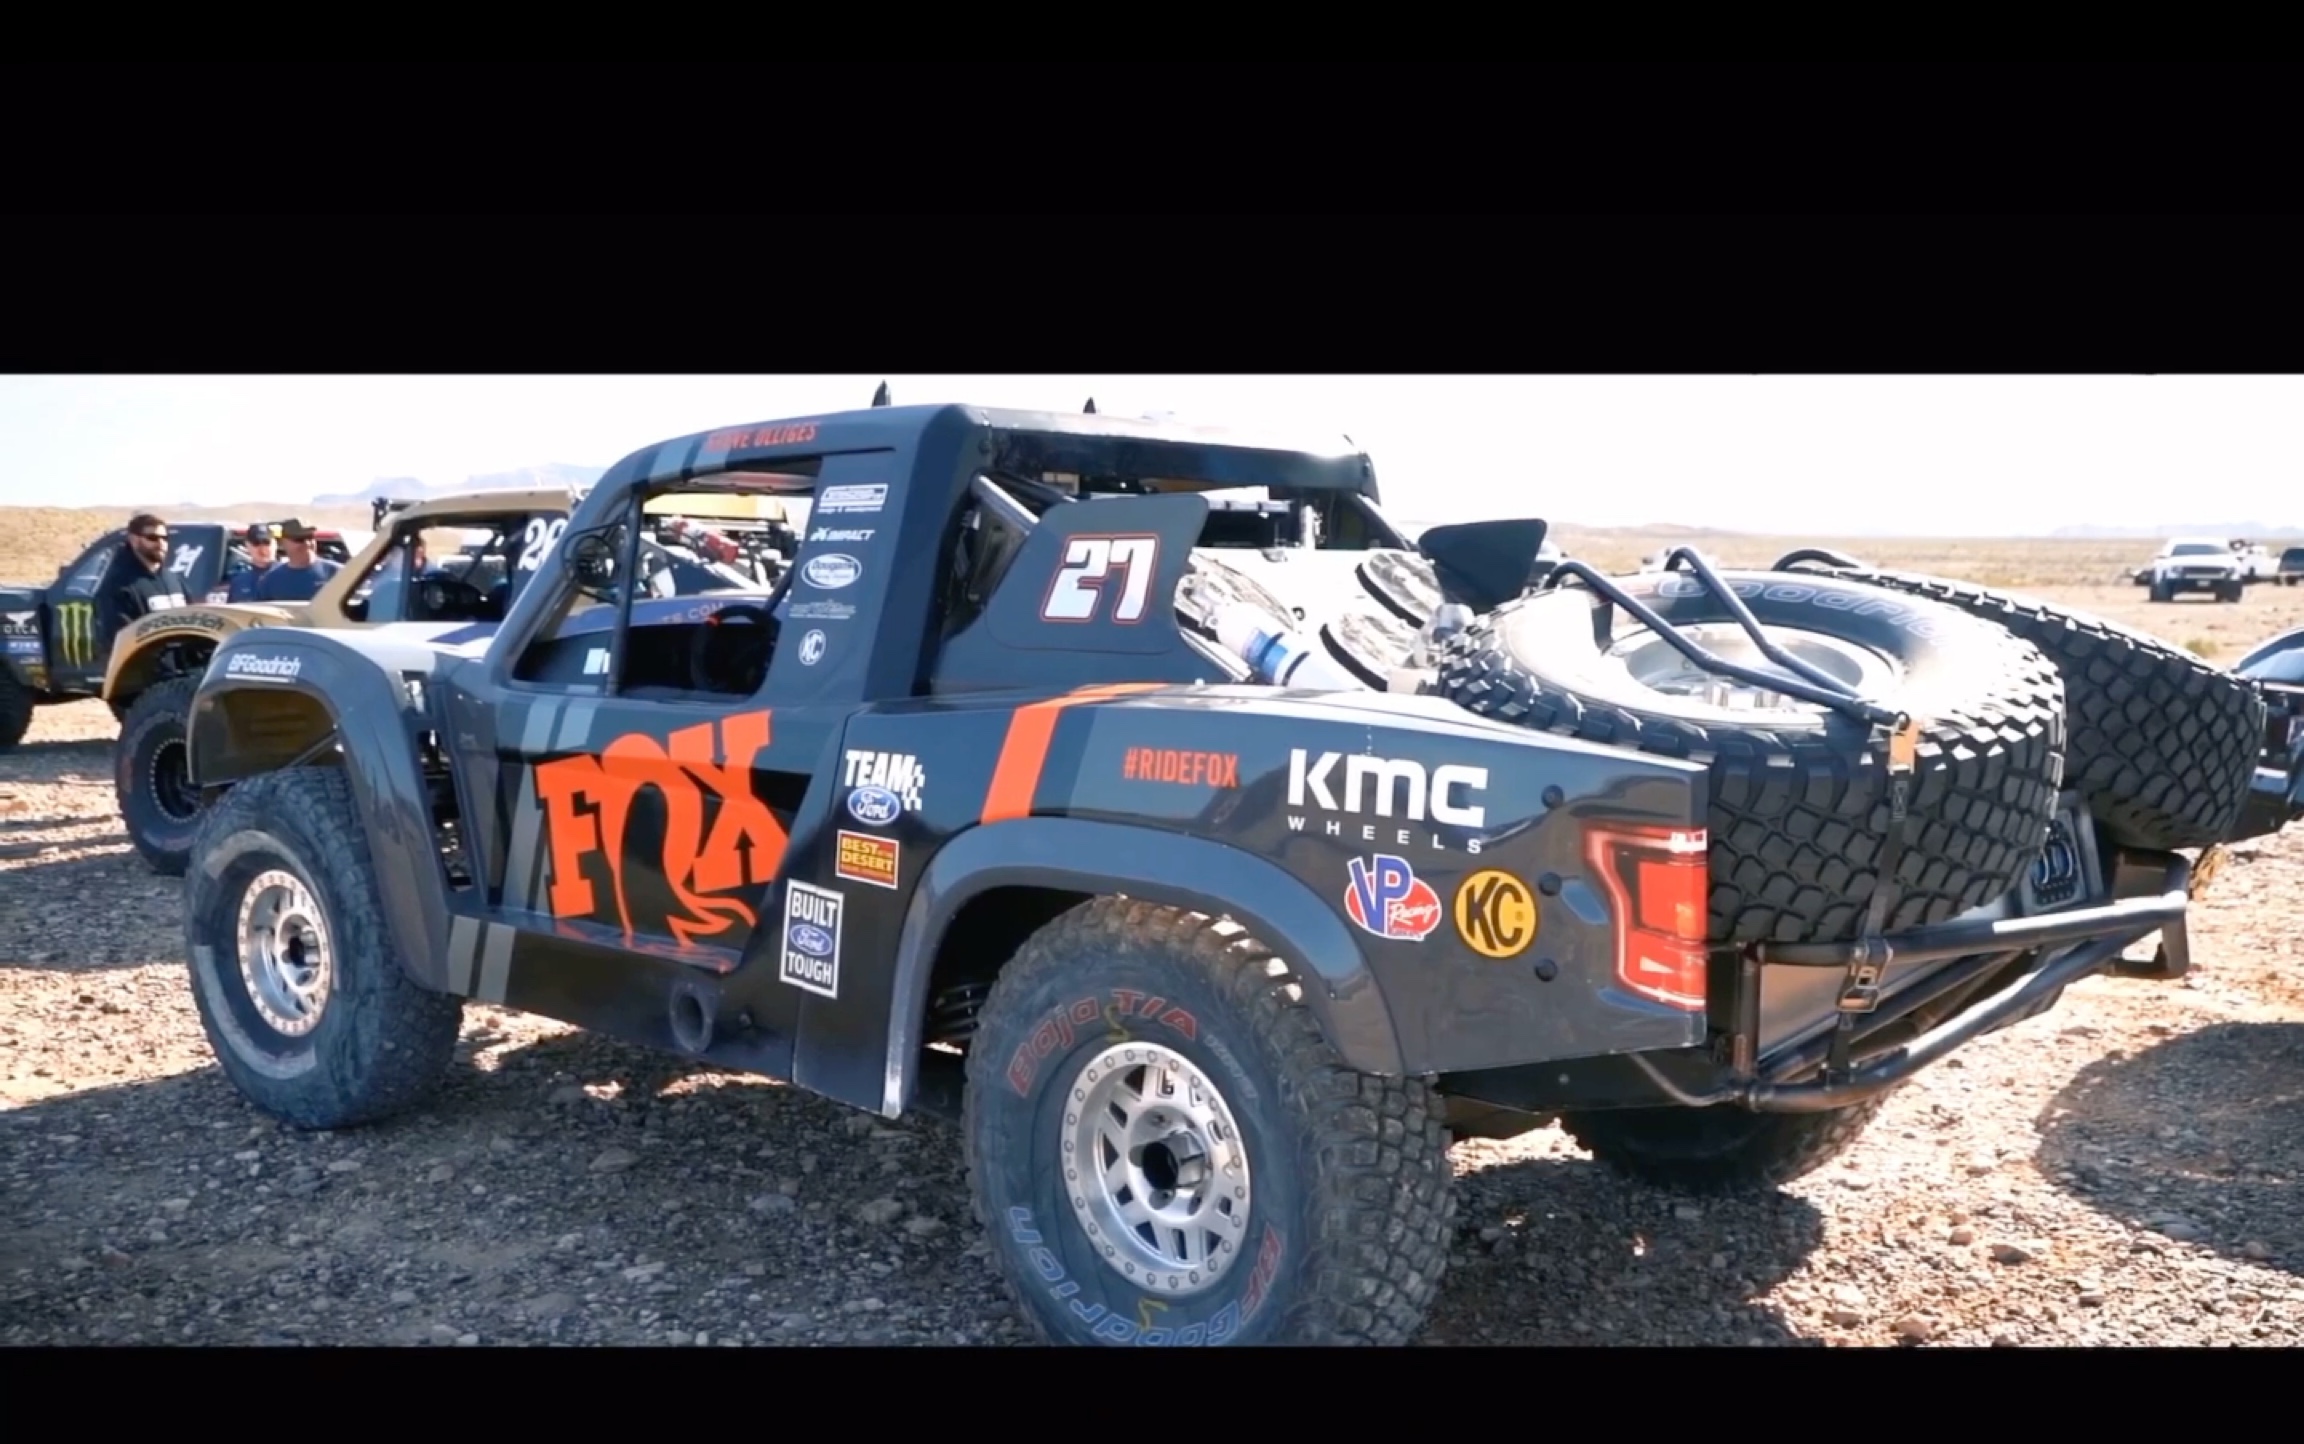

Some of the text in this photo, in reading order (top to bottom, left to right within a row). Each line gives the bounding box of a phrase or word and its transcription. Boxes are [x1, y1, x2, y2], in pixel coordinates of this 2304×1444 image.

[1041, 534, 1158, 623] 27
[227, 653, 301, 676] BFGoodrich
[844, 749, 917, 792] TEAM
[1124, 747, 1239, 788] #RIDEFOX
[857, 790, 892, 819] Ford
[1287, 748, 1489, 828] KMC
[534, 710, 789, 949] FOX
[841, 838, 879, 855] BEST
[1288, 816, 1482, 853] WHEELS
[841, 851, 894, 872] DESERT
[791, 891, 837, 928] BUILT
[1347, 854, 1413, 934] VP
[1388, 903, 1438, 926] Racing
[1465, 876, 1524, 951] KC
[796, 927, 825, 951] Ford
[787, 951, 832, 985] TOUGH
[1007, 996, 1098, 1098] Baja
